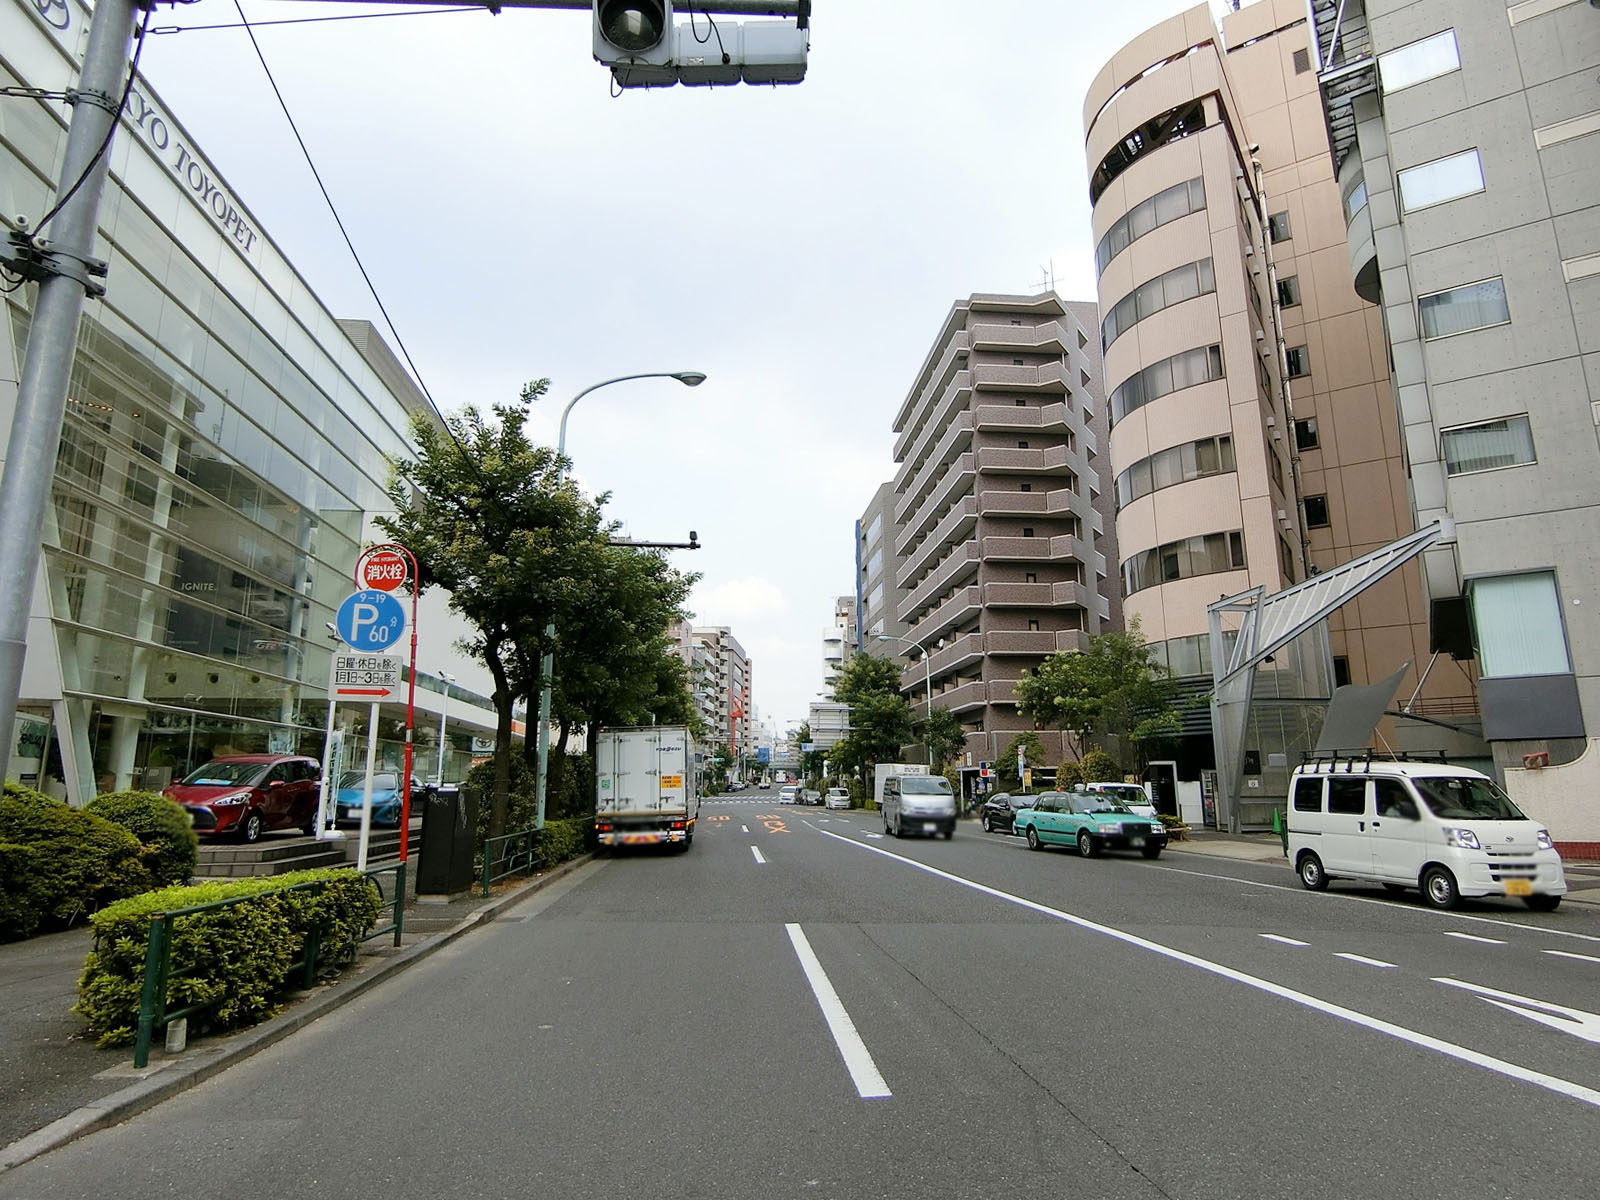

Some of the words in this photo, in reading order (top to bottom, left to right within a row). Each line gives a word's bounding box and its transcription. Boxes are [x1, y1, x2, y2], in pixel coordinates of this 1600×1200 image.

[174, 143, 257, 253] TOYOPET
[367, 563, 404, 581] 消火栓
[359, 592, 387, 604] 9-19
[350, 602, 379, 642] P
[369, 625, 389, 643] 60
